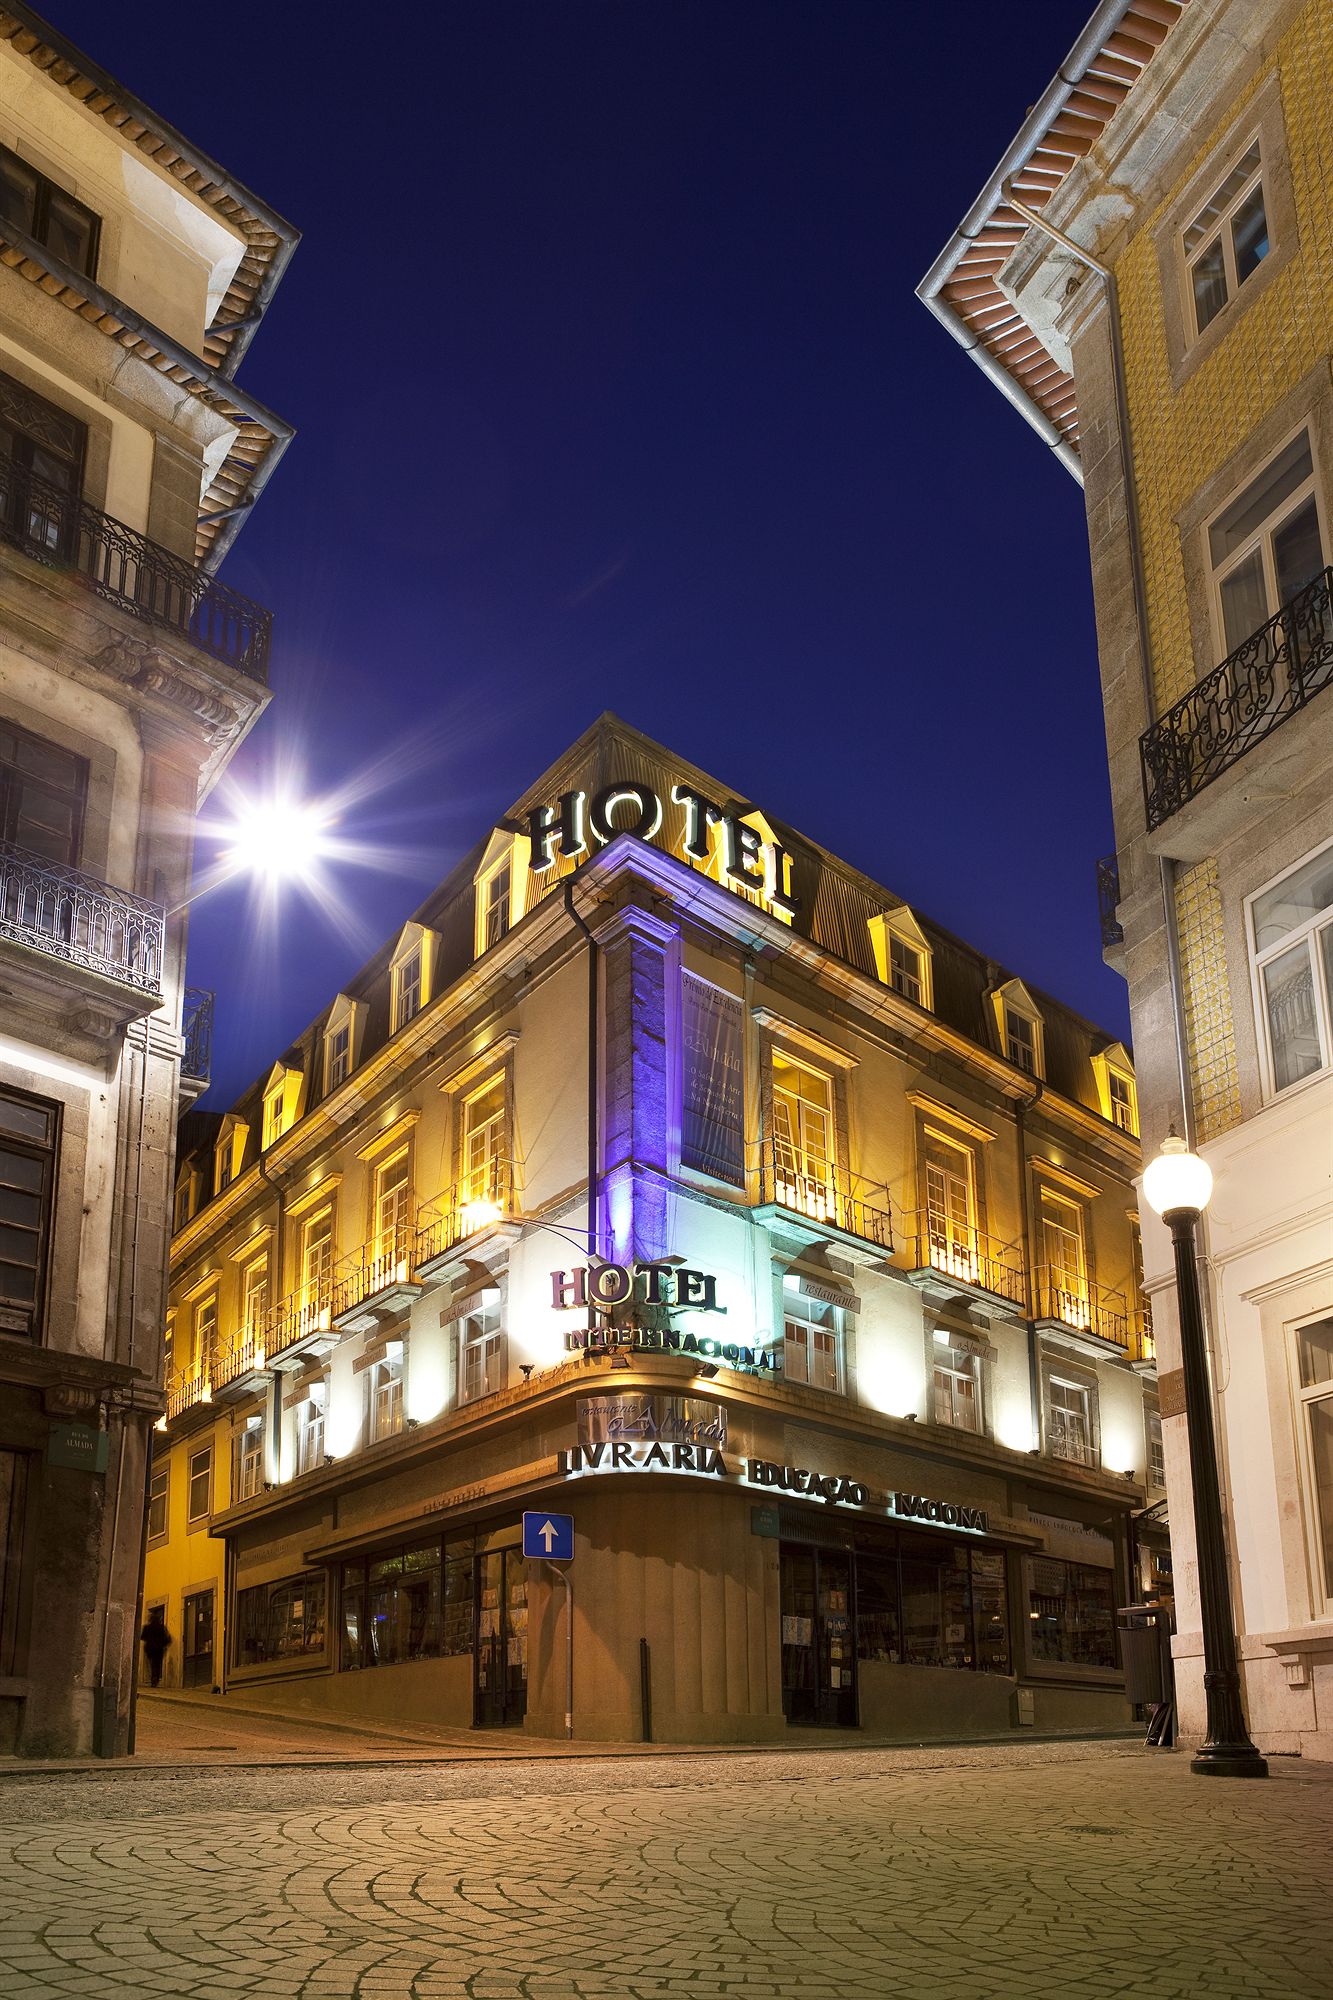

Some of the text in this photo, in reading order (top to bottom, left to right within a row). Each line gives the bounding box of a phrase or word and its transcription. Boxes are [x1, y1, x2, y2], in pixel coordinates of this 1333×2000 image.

[527, 781, 801, 917] HOTEL
[550, 1263, 727, 1314] HOTEL
[805, 1284, 856, 1309] restaurante
[563, 1326, 781, 1372] INTERNACIONAL
[66, 1439, 94, 1450] ALMADA
[557, 1442, 728, 1476] LIVRARIA
[747, 1459, 871, 1505] EDUCAÇÃO
[894, 1492, 993, 1533] NACIONAL
